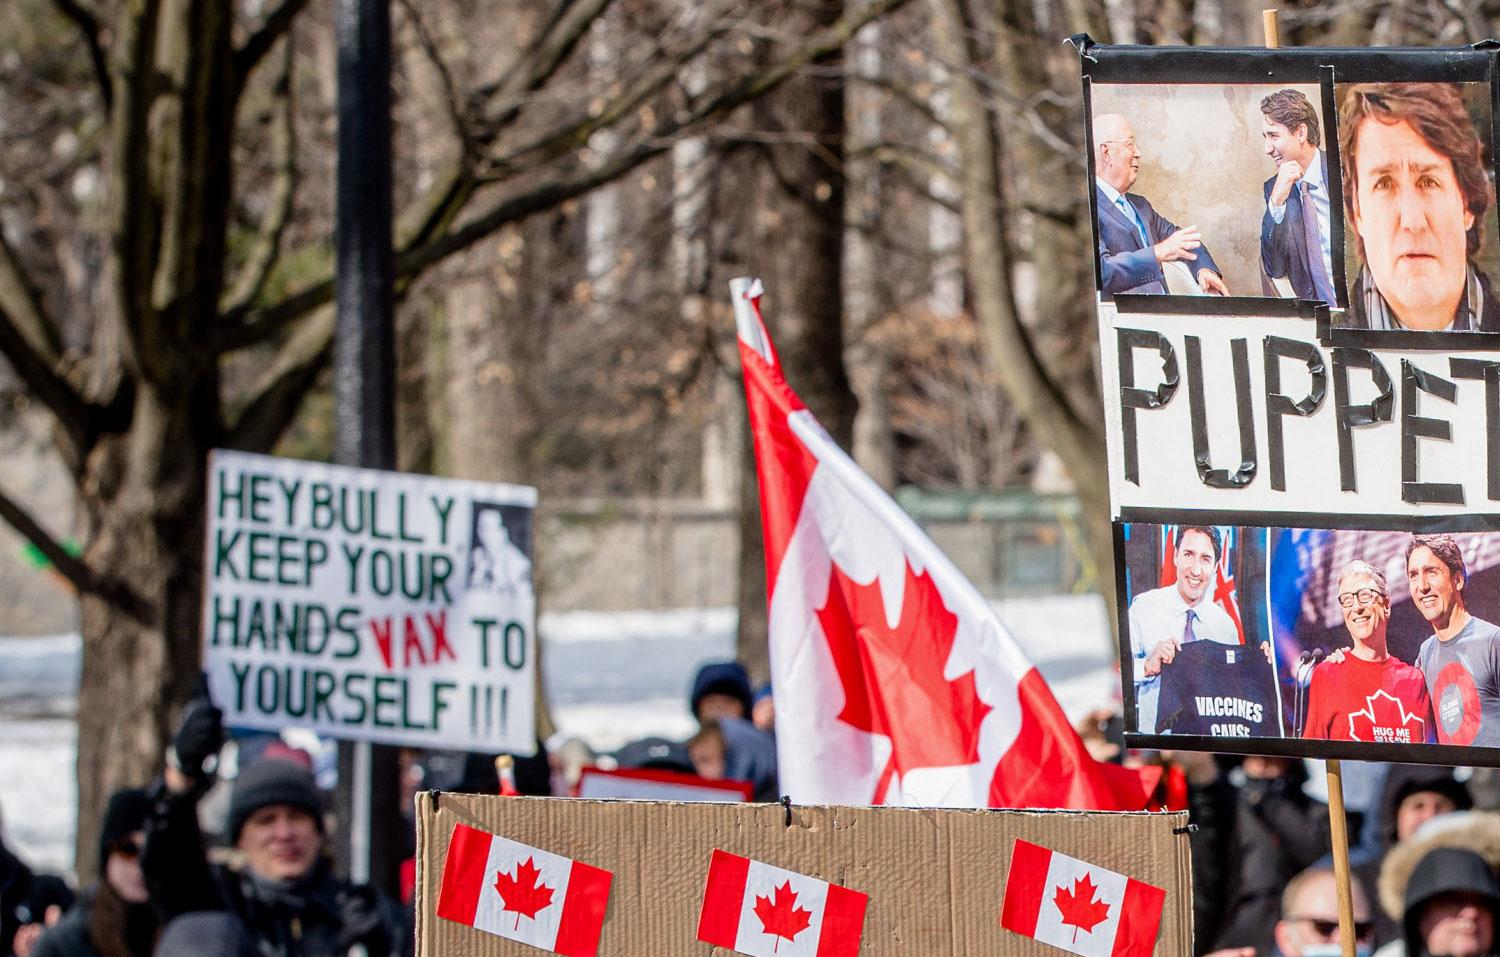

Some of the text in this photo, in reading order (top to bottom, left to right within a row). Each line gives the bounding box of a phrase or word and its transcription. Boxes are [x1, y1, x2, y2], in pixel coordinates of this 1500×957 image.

[215, 528, 456, 604] KEEP YOUR
[212, 597, 526, 672] HANDS VAX TO
[231, 661, 456, 731] YOURSELF
[1195, 696, 1263, 723] VACCINES
[1373, 726, 1410, 738] HUG ME
